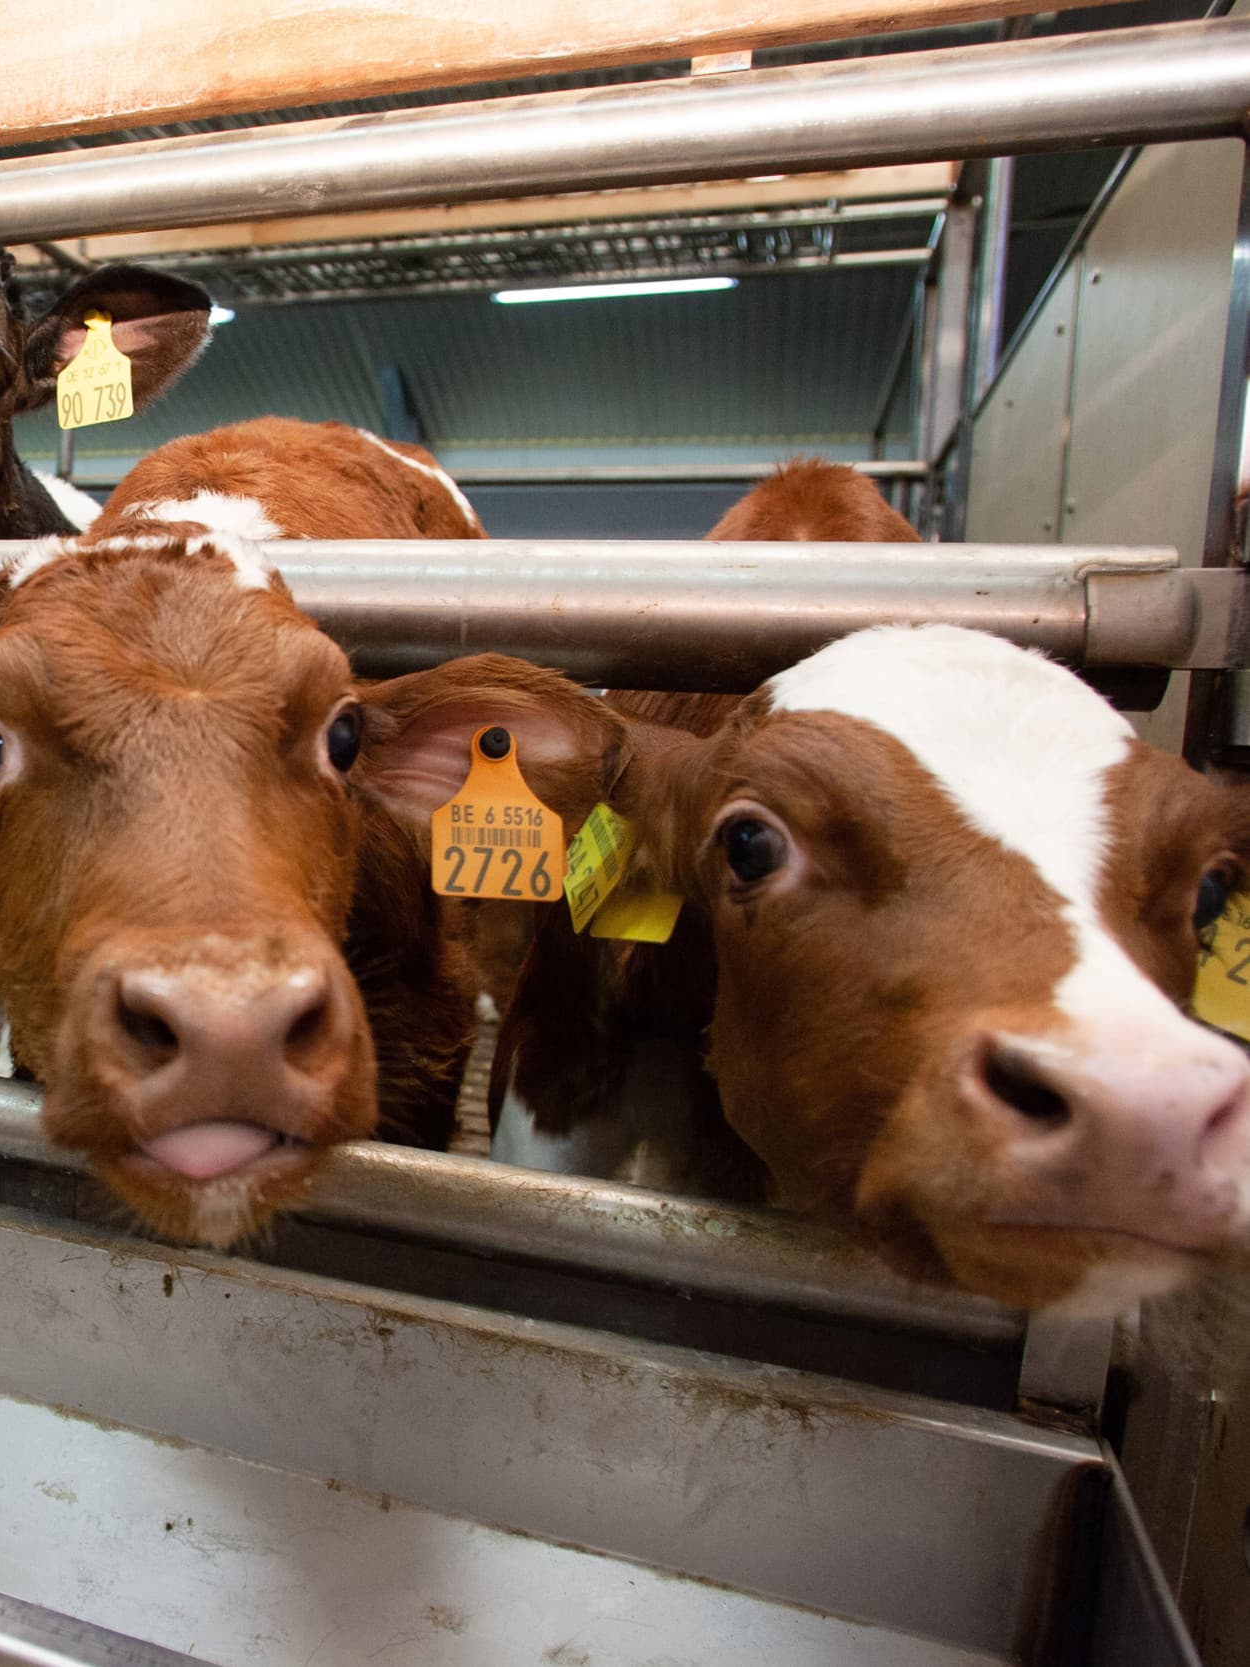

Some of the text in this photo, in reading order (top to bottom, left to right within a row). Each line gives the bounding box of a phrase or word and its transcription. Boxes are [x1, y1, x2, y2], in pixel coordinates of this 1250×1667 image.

[61, 382, 127, 428] 90 739
[450, 804, 544, 828] BE 6 5516
[443, 845, 551, 898] 2726
